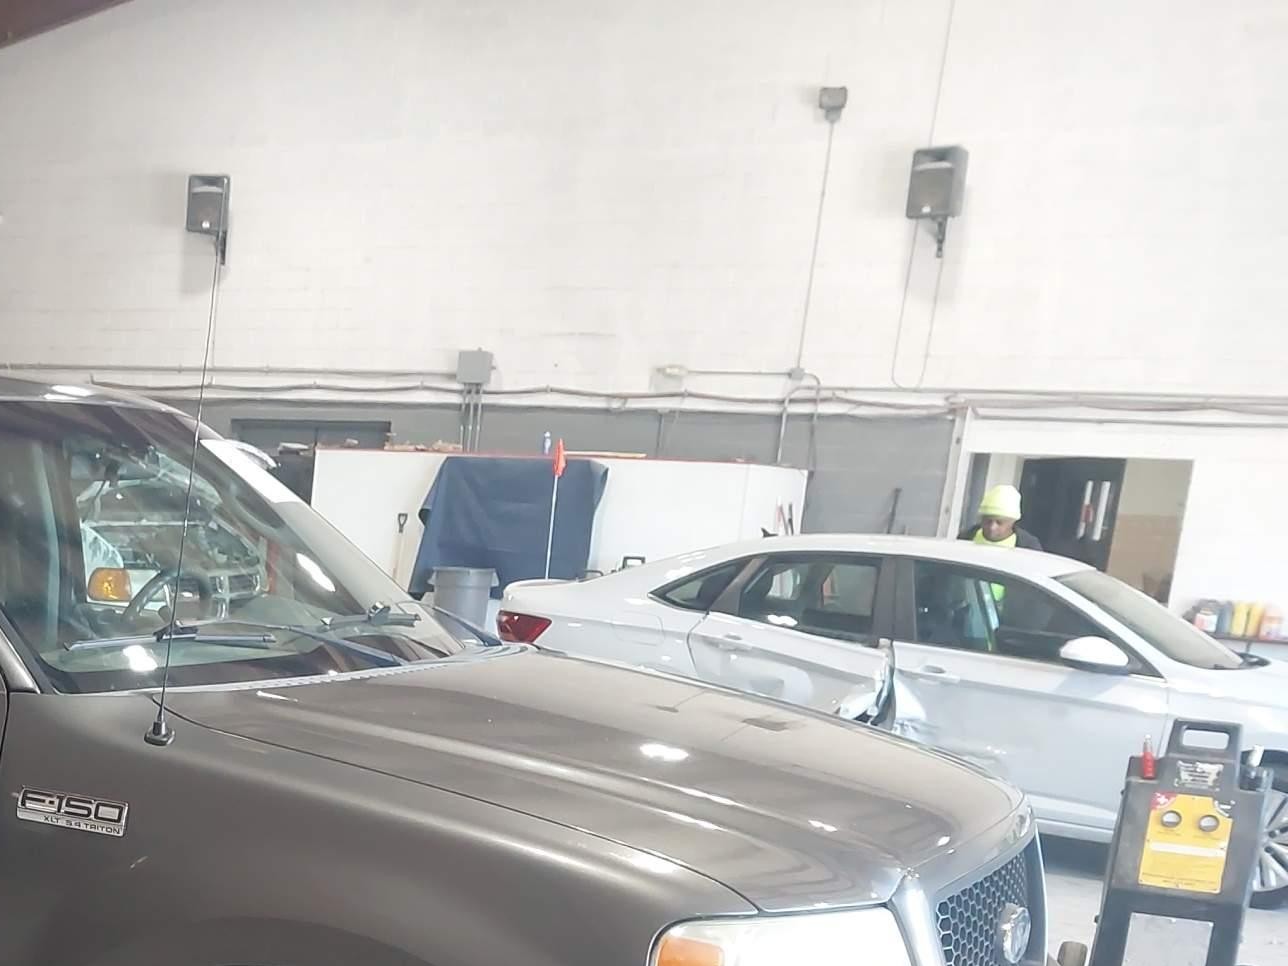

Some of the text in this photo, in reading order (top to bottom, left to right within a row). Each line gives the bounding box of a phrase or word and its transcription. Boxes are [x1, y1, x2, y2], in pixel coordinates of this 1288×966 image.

[19, 788, 124, 824] F-150
[43, 815, 60, 824] XLT
[84, 822, 121, 835] TRITON
